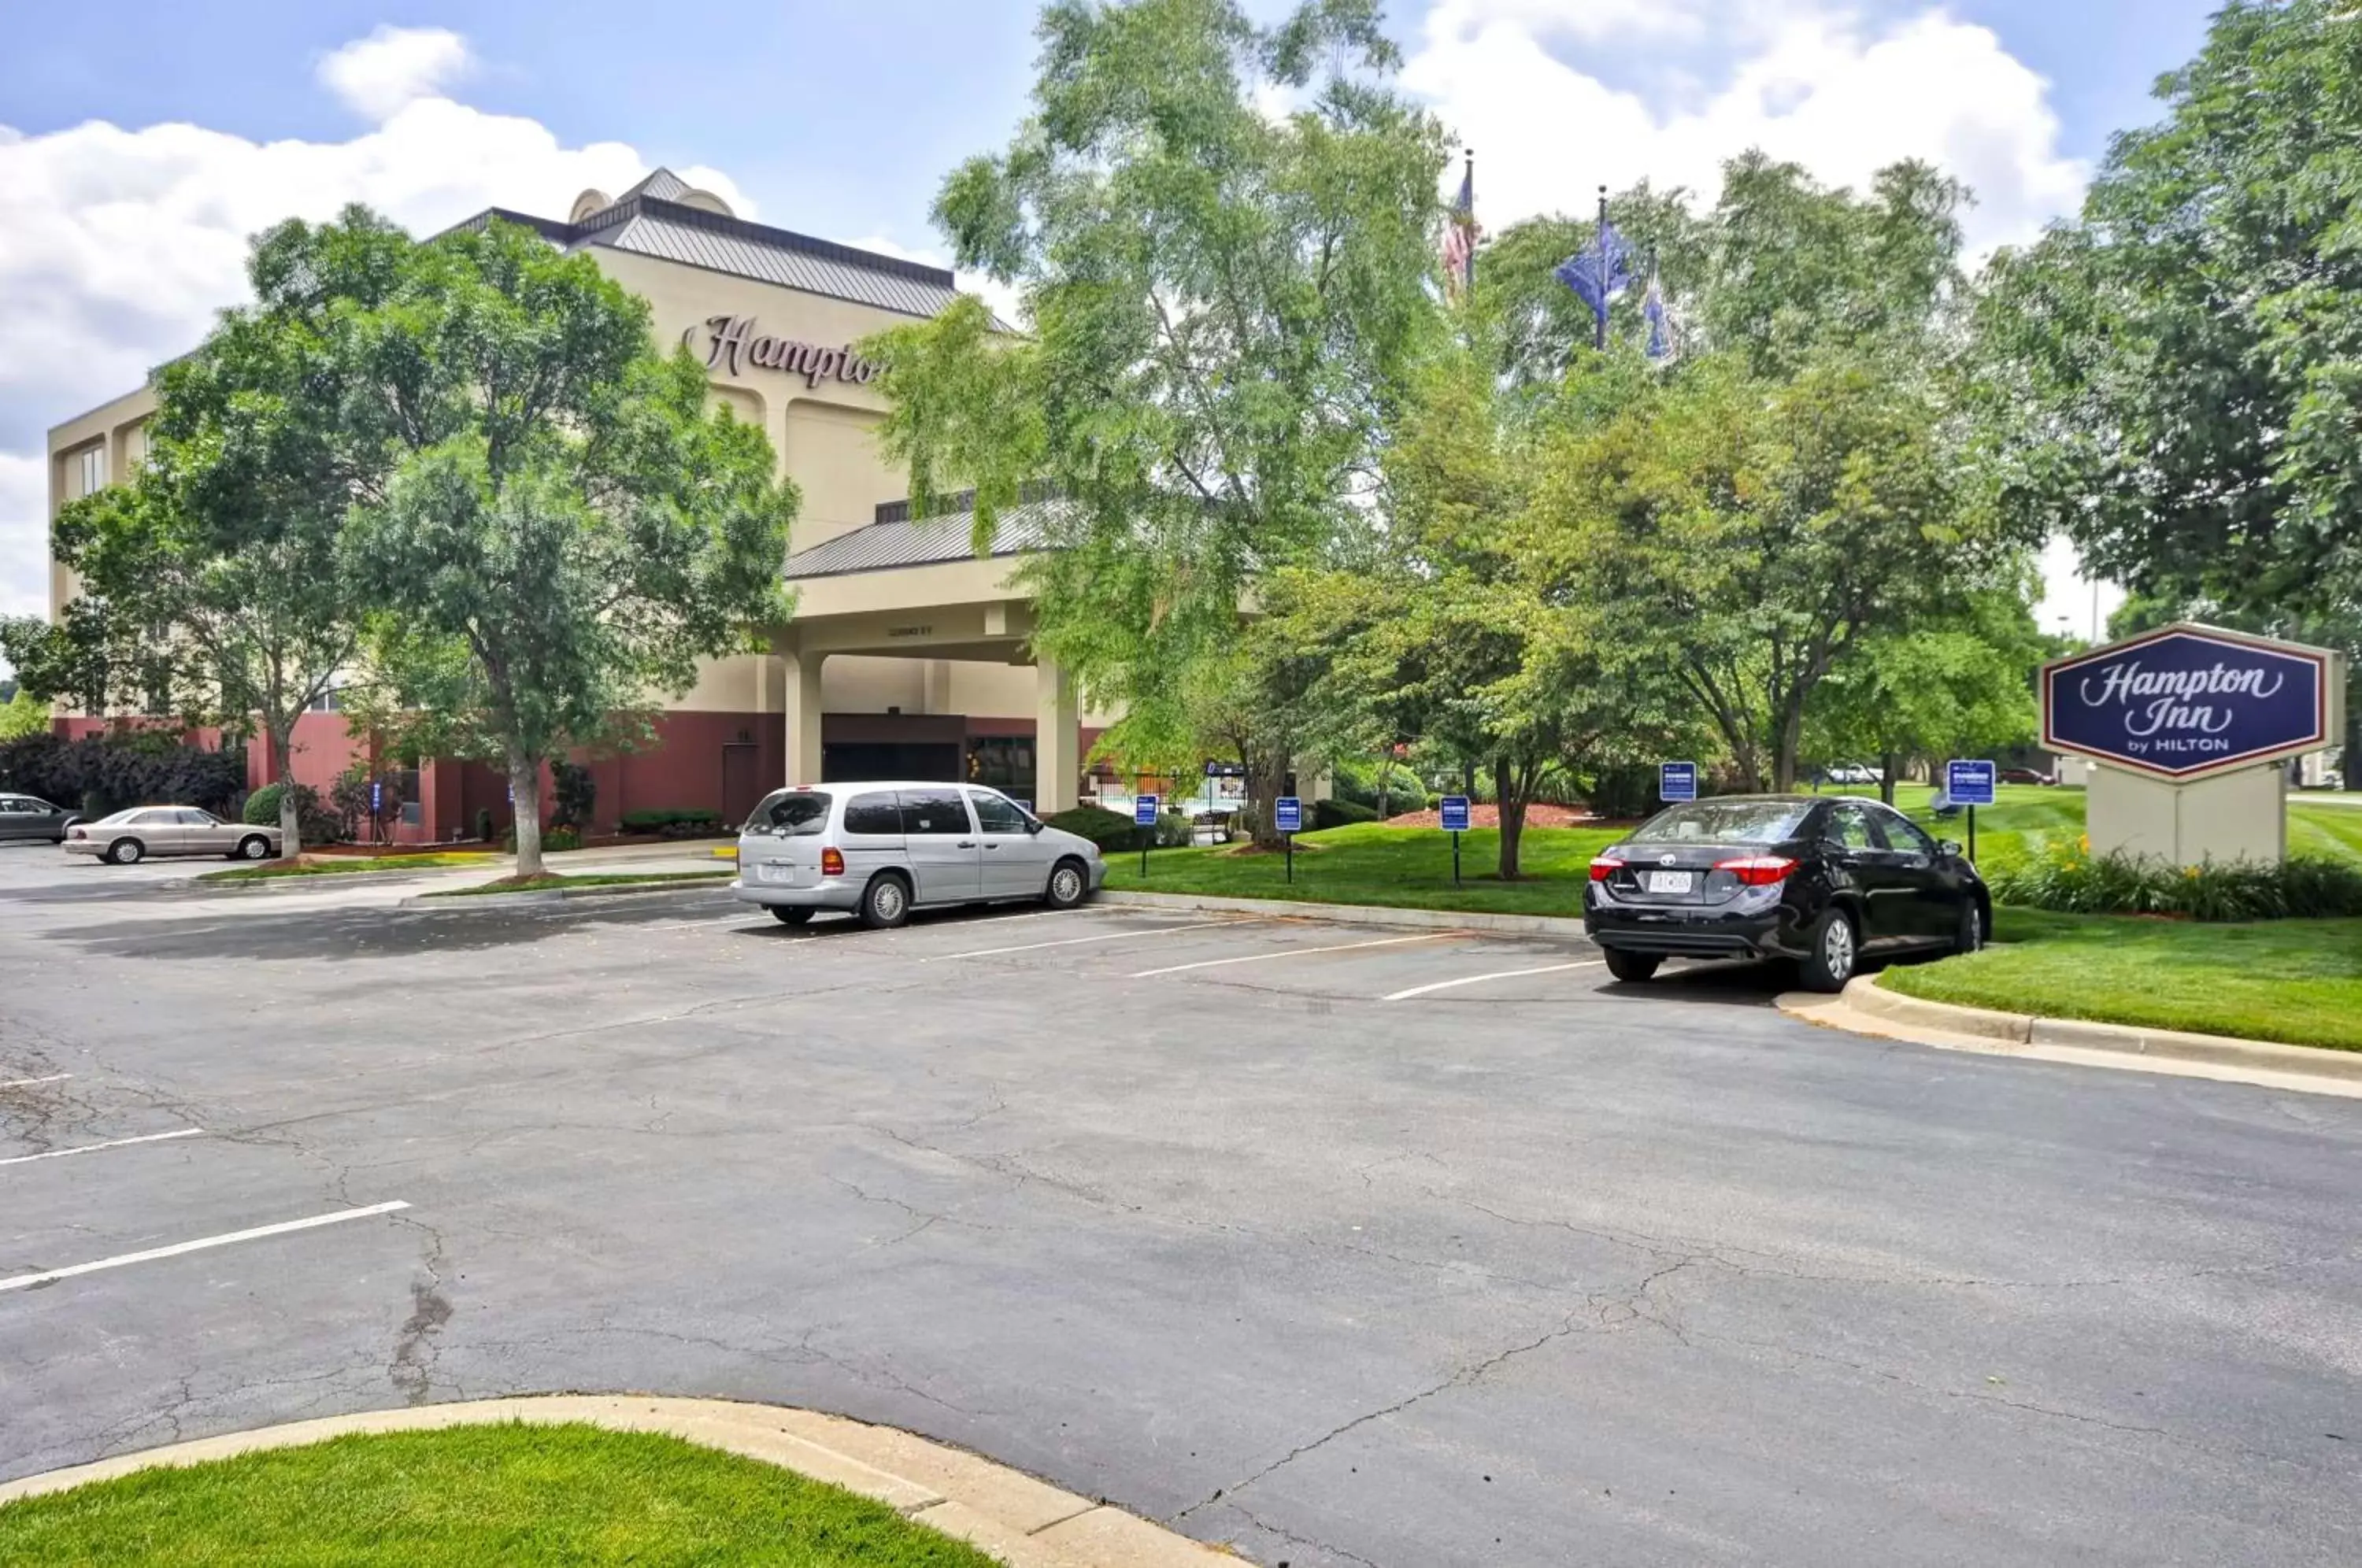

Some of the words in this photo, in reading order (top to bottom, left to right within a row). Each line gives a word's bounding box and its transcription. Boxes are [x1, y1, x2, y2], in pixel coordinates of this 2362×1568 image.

[2080, 660, 2283, 707] Hampton
[2124, 697, 2233, 736] Inn
[2127, 739, 2149, 754] by
[2155, 738, 2230, 751] HILTON
